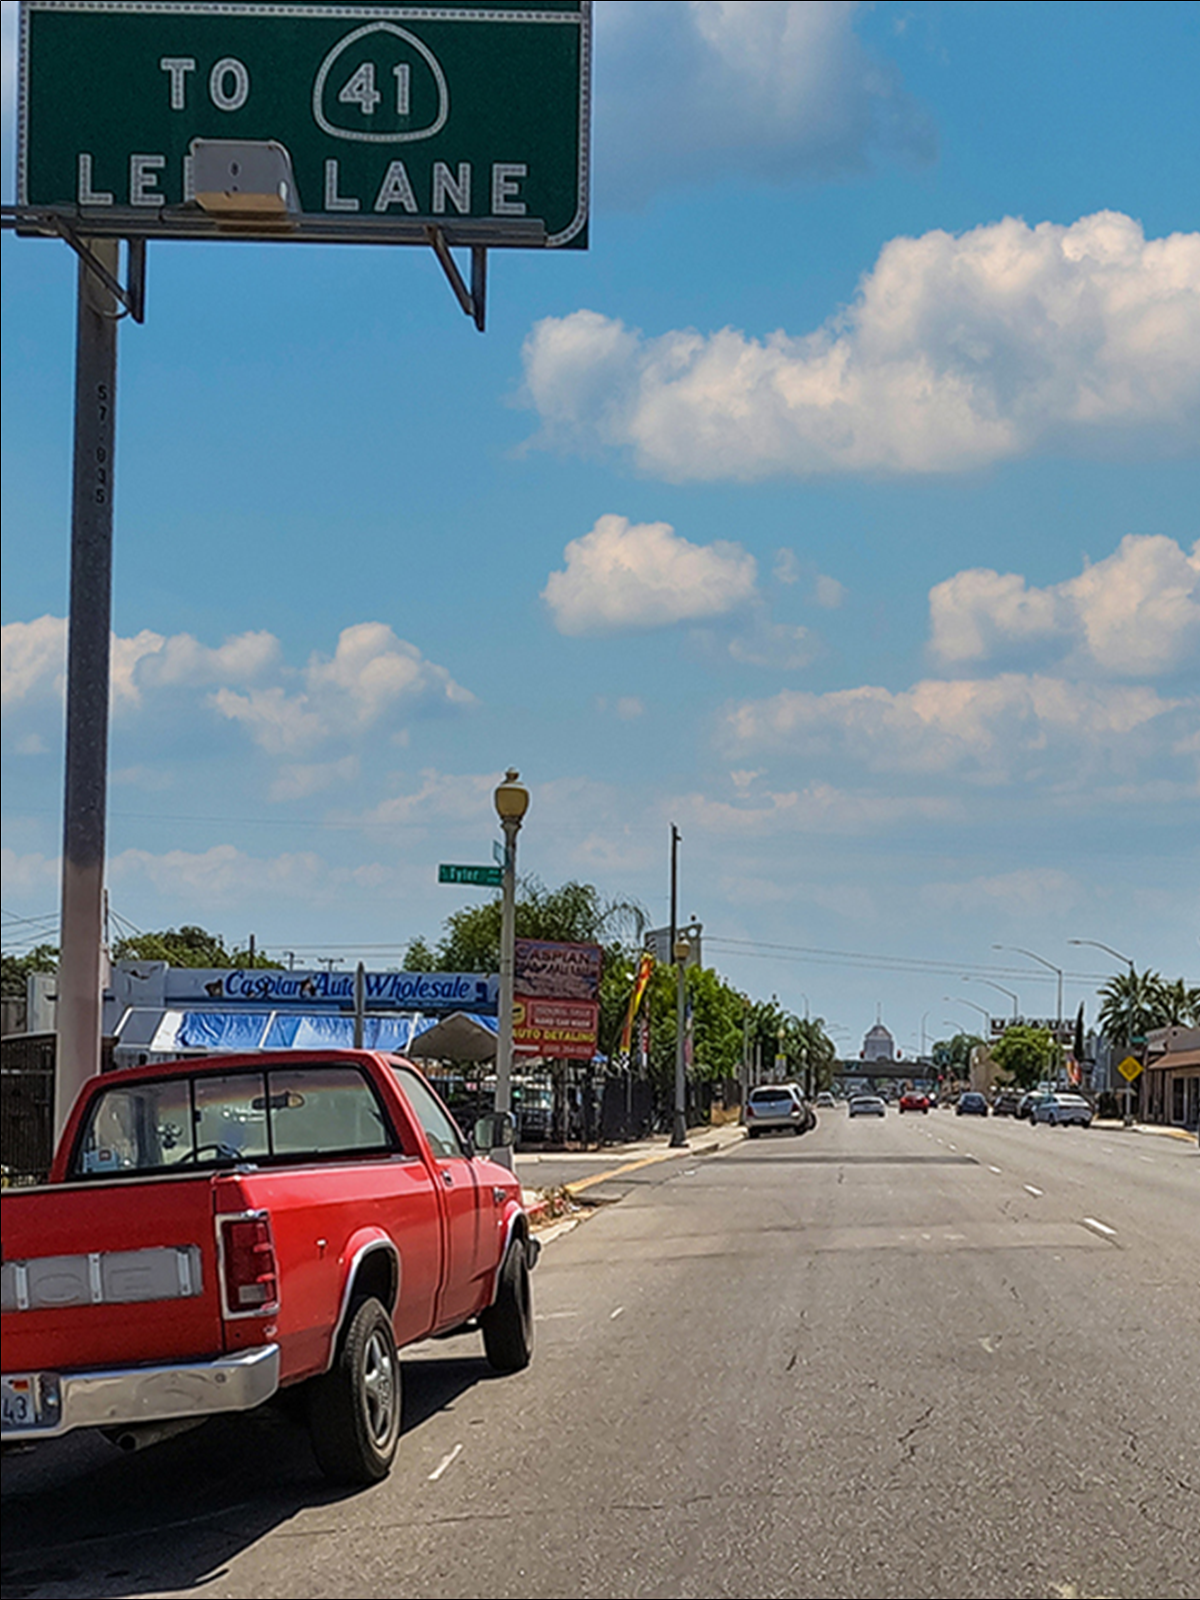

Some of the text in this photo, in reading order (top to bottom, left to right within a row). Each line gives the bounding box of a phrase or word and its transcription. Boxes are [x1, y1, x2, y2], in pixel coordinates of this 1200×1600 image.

[160, 57, 412, 116] TO 41
[78, 153, 528, 215] LE LANE
[514, 943, 591, 964] CASPIAN
[225, 970, 303, 999] Caspian
[365, 974, 471, 1001] Wholesale
[513, 1028, 541, 1040] AUTO
